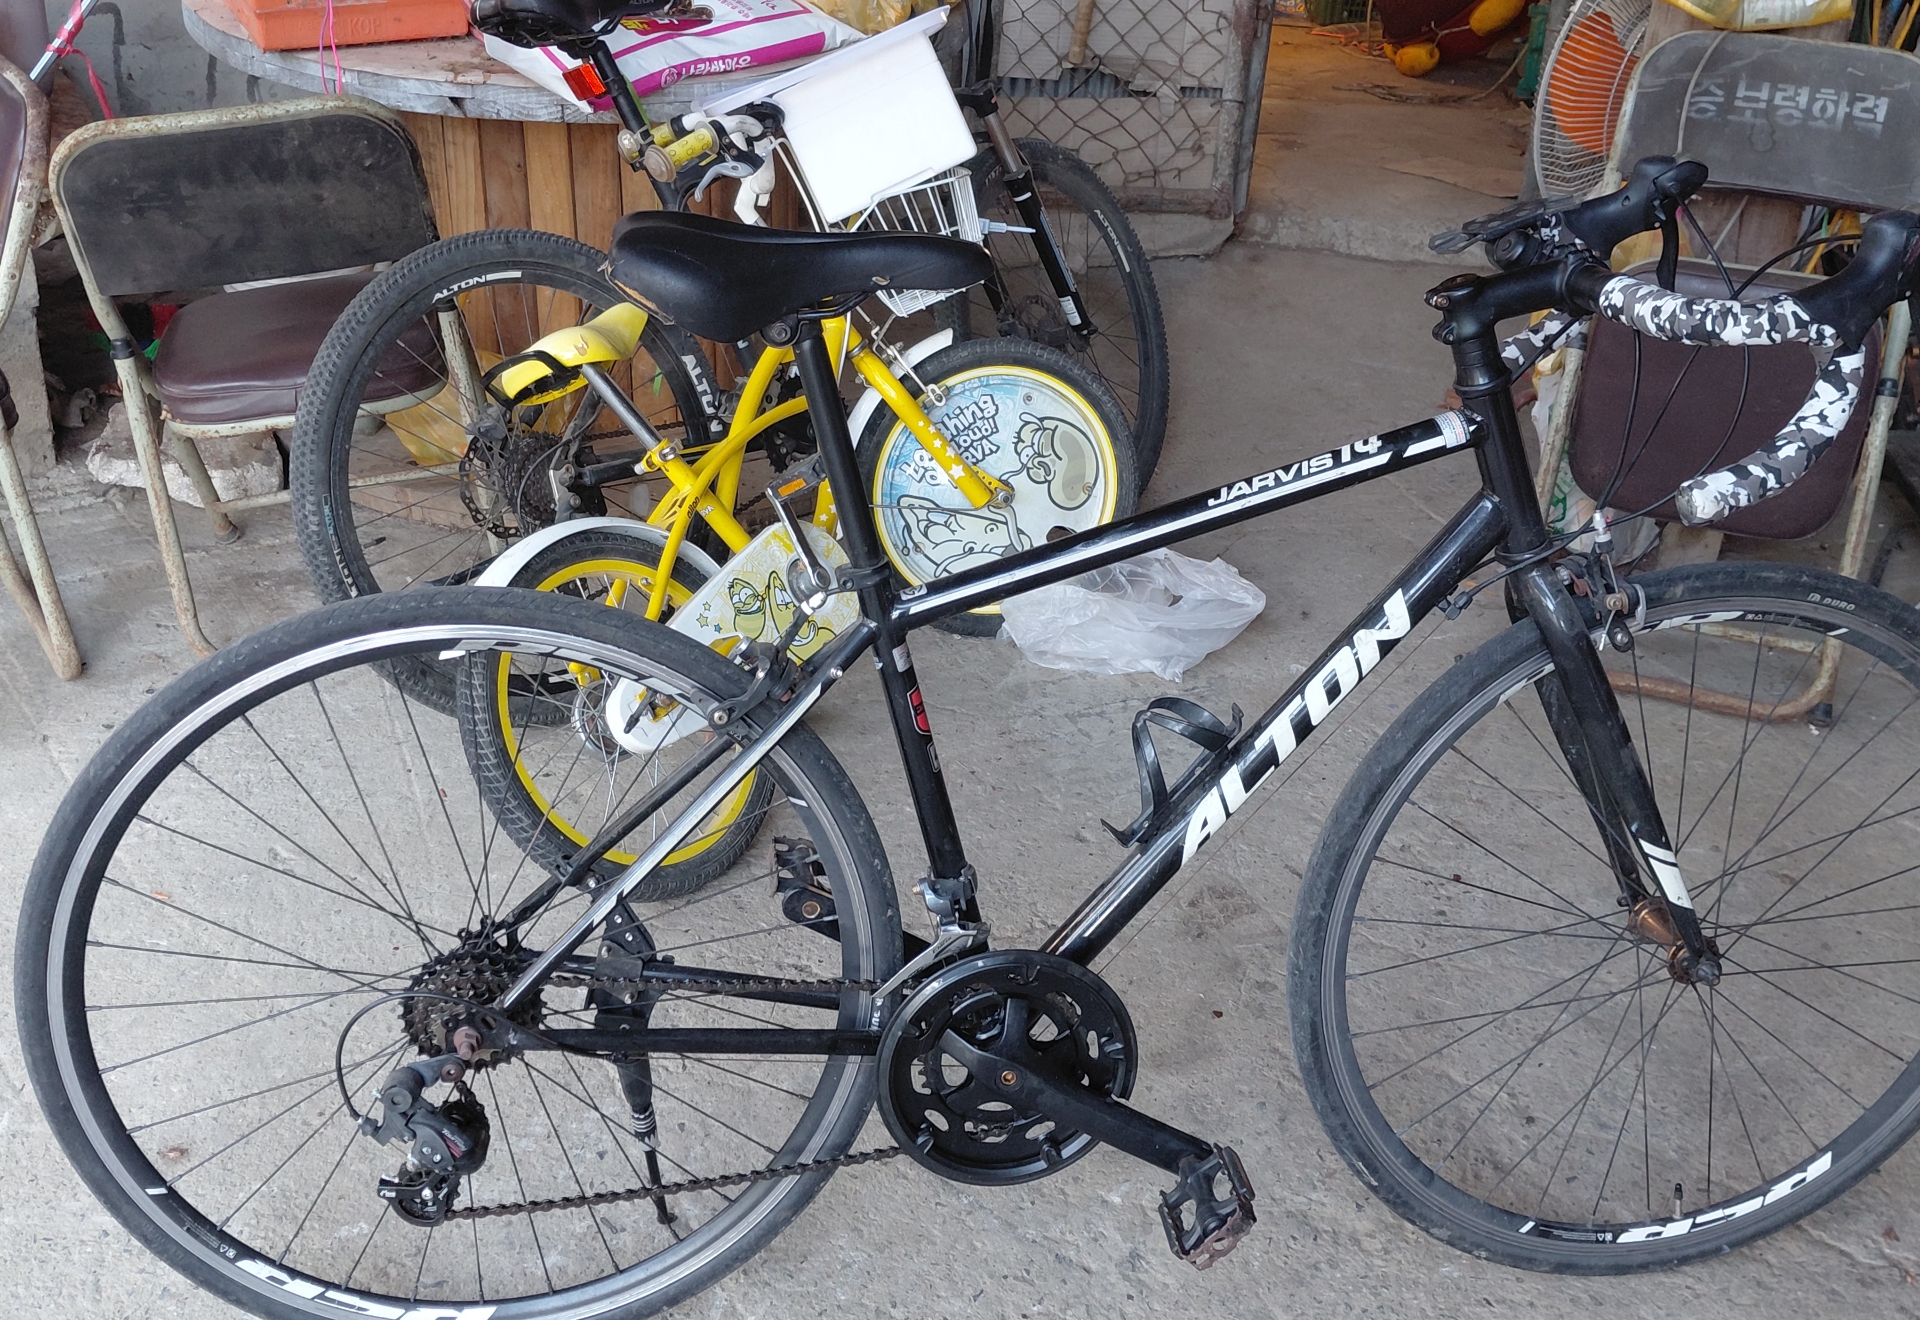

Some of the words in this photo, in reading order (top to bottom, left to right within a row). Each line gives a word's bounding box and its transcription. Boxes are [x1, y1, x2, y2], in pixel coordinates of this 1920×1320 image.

[1093, 209, 1120, 246] ALTON
[431, 274, 486, 304] ALTON
[1207, 453, 1334, 507] JARVIS
[1334, 434, 1383, 464] 14
[1822, 597, 1856, 611] DURO
[1181, 587, 1411, 867] ALTON
